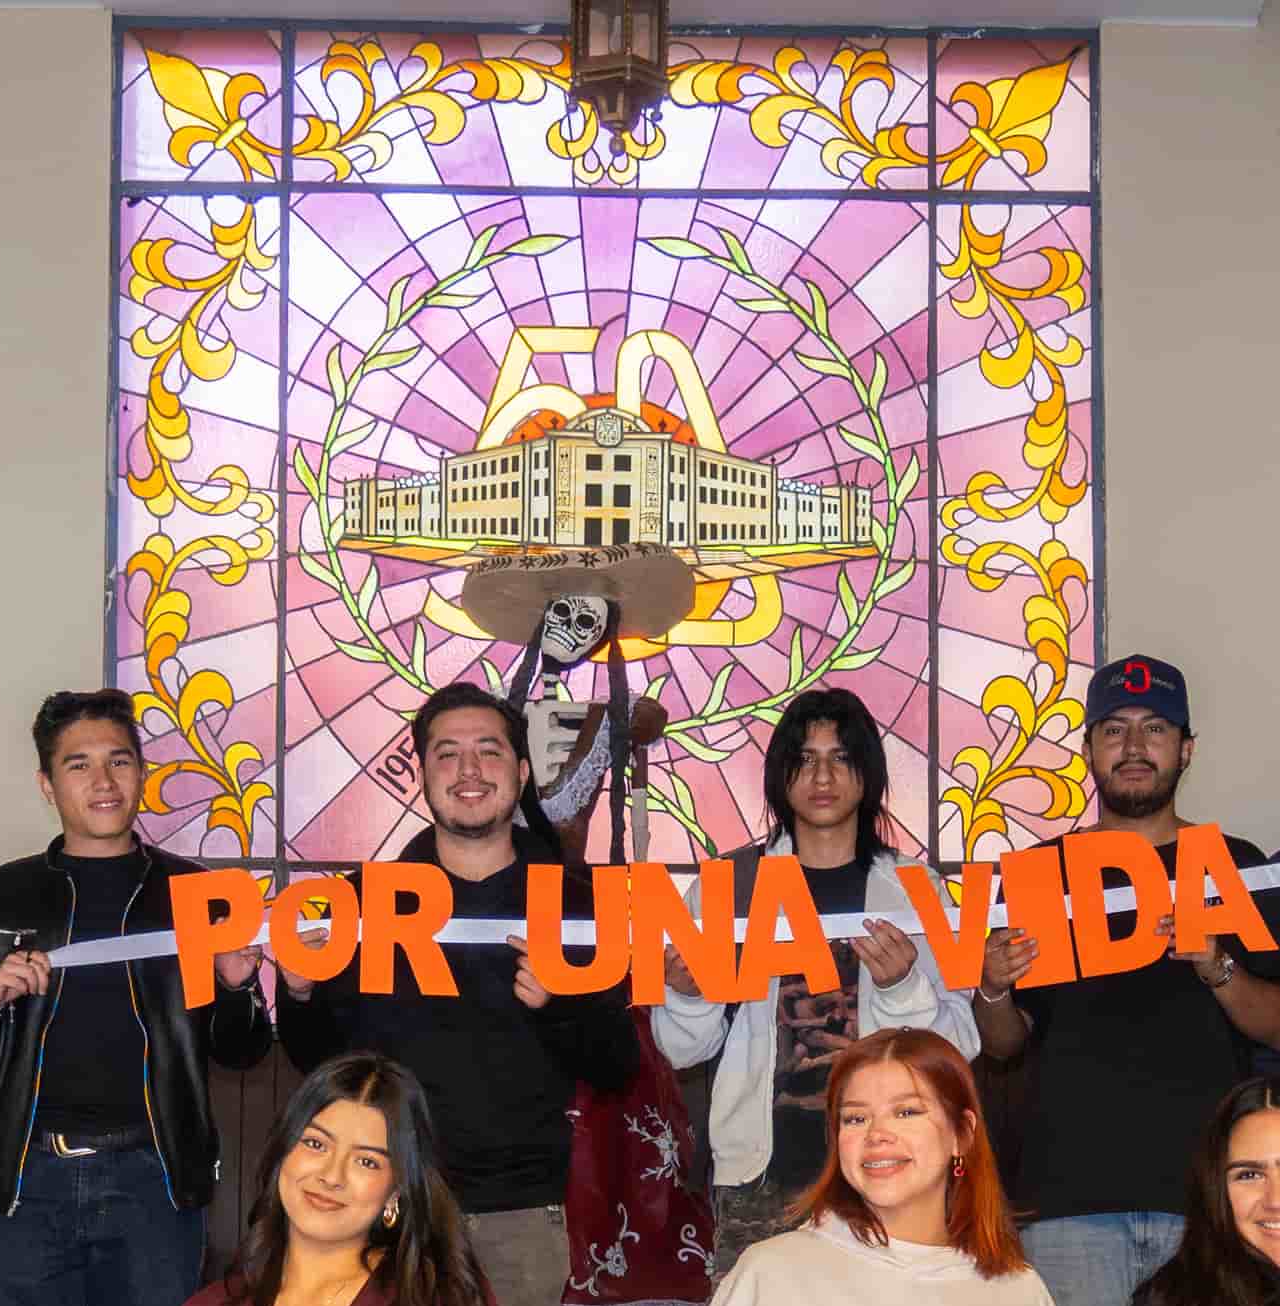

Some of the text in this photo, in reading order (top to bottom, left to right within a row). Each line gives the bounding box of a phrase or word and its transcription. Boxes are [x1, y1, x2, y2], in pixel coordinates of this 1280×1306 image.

[168, 823, 1280, 1009] POR UNA VIDA
